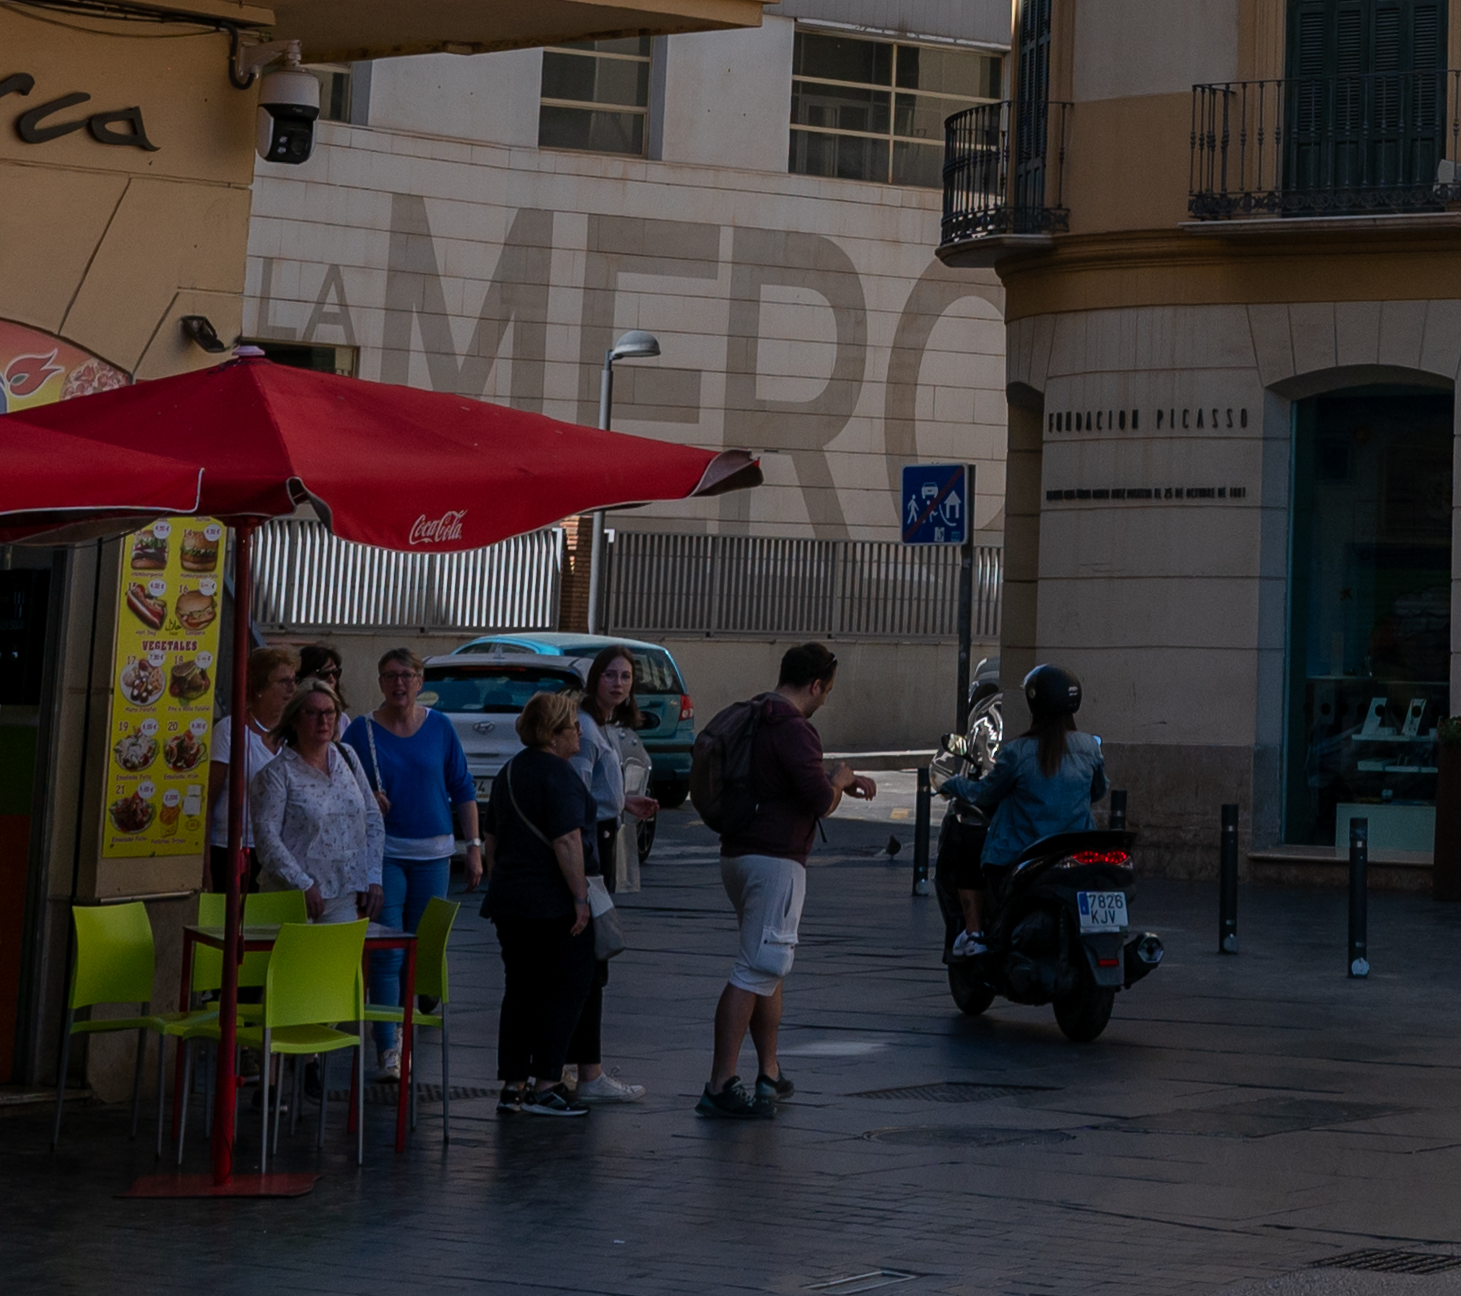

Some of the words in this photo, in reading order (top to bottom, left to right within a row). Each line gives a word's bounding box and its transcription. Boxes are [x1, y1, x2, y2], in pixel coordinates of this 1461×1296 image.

[258, 257, 356, 345] LA
[1157, 408, 1248, 429] PICASSO
[142, 640, 197, 651] VEGETALES
[119, 721, 129, 731] 19
[167, 721, 179, 732] 20
[115, 784, 125, 794] 21
[1088, 894, 1123, 909] 7826
[1091, 909, 1116, 924] KJV
